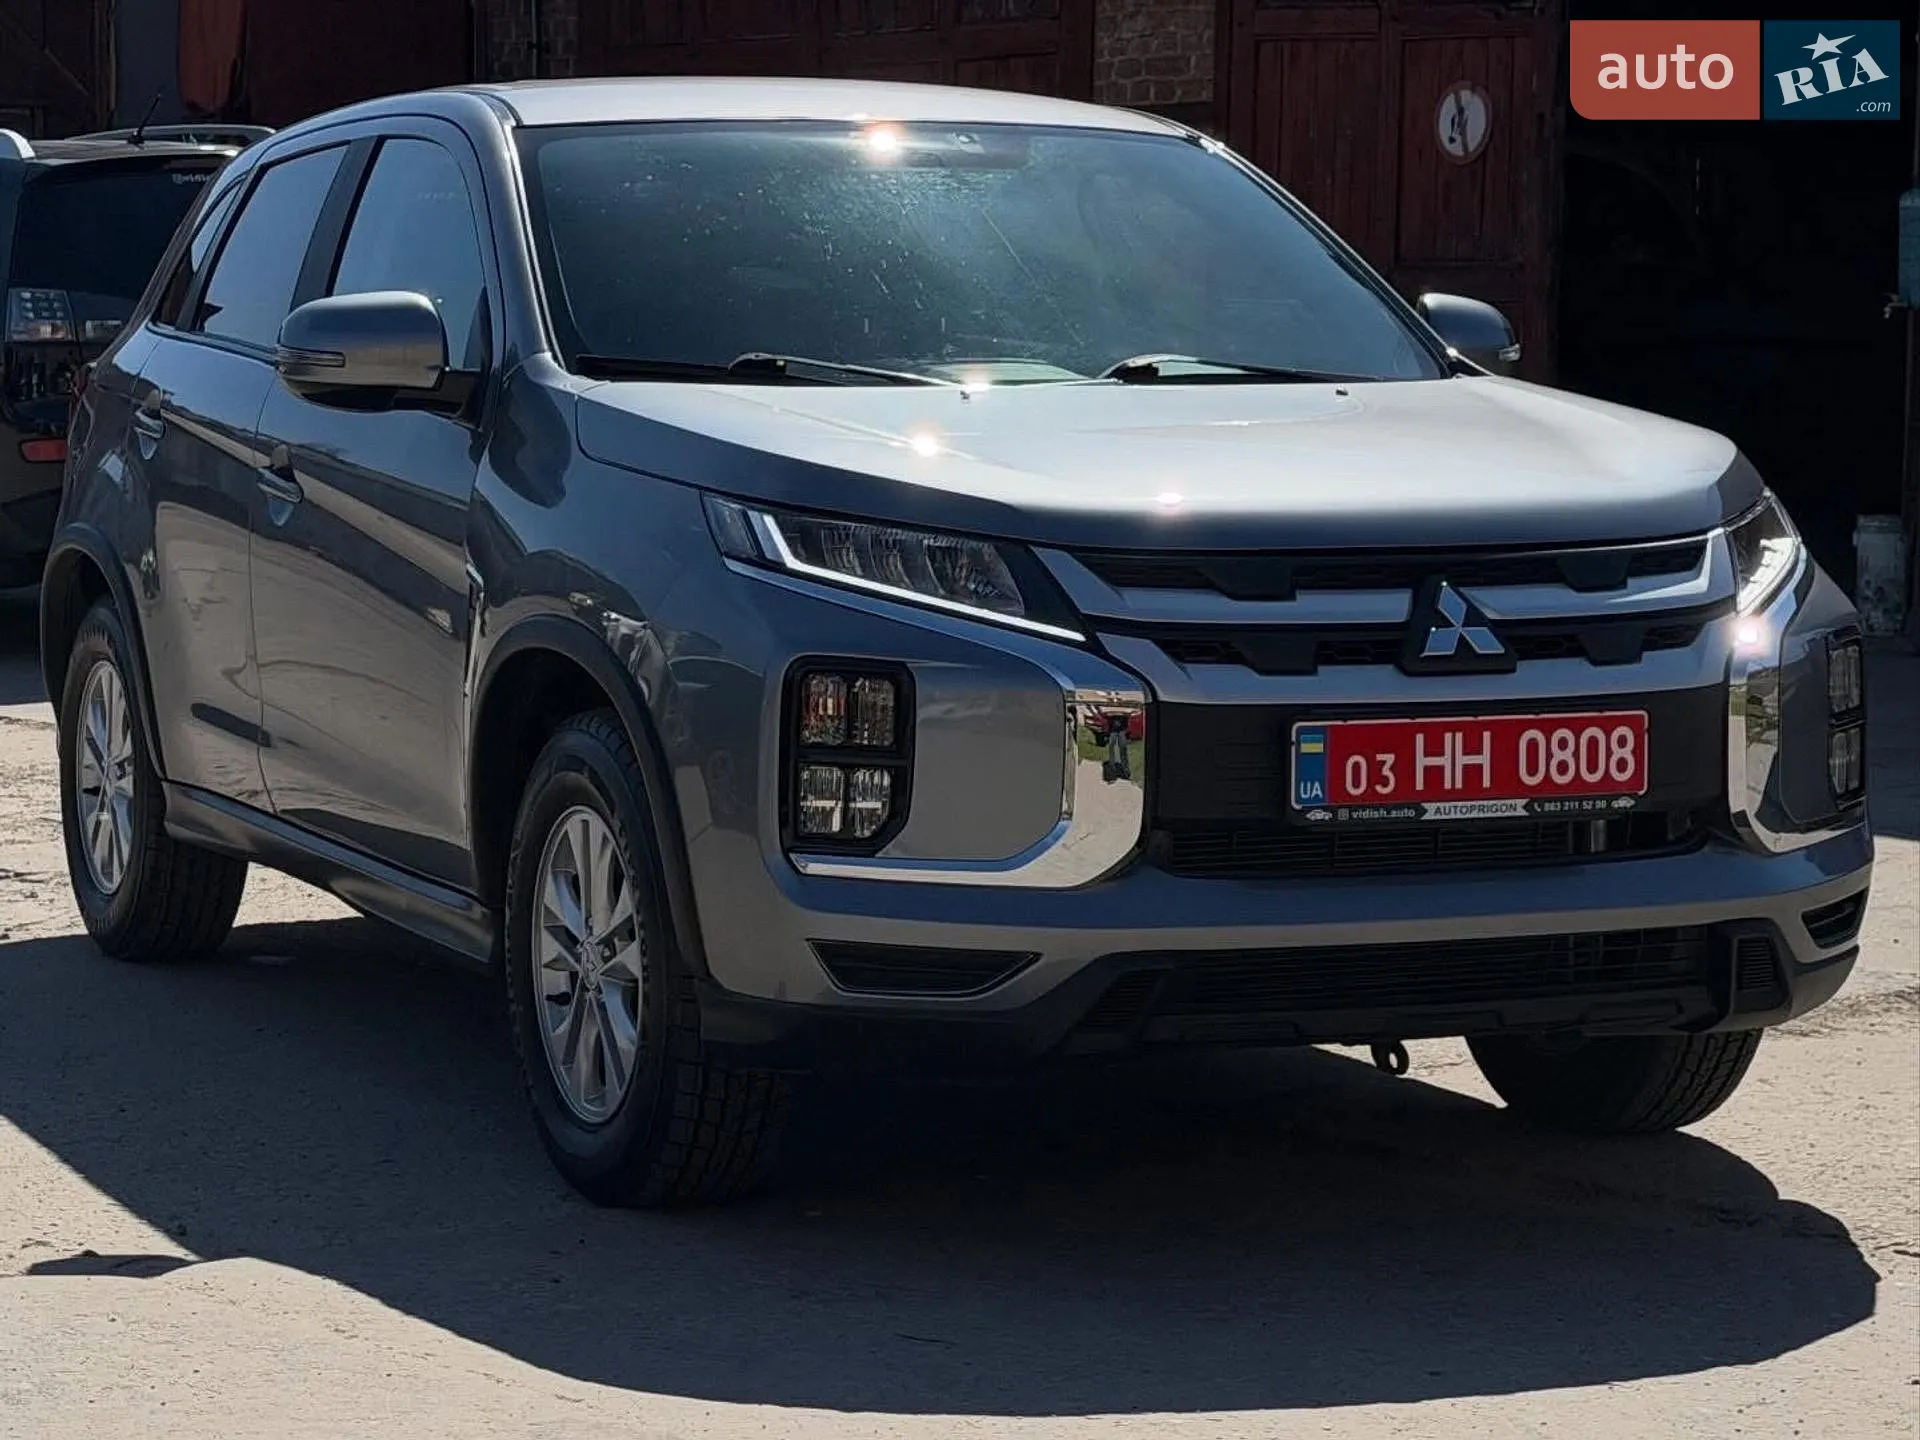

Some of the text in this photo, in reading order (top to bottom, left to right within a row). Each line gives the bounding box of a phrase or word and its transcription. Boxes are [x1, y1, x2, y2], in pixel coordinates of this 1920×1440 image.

[1345, 726, 1636, 796] 03 HH 0808
[1300, 781, 1323, 800] UA
[1434, 803, 1518, 817] AUTOPRIGON
